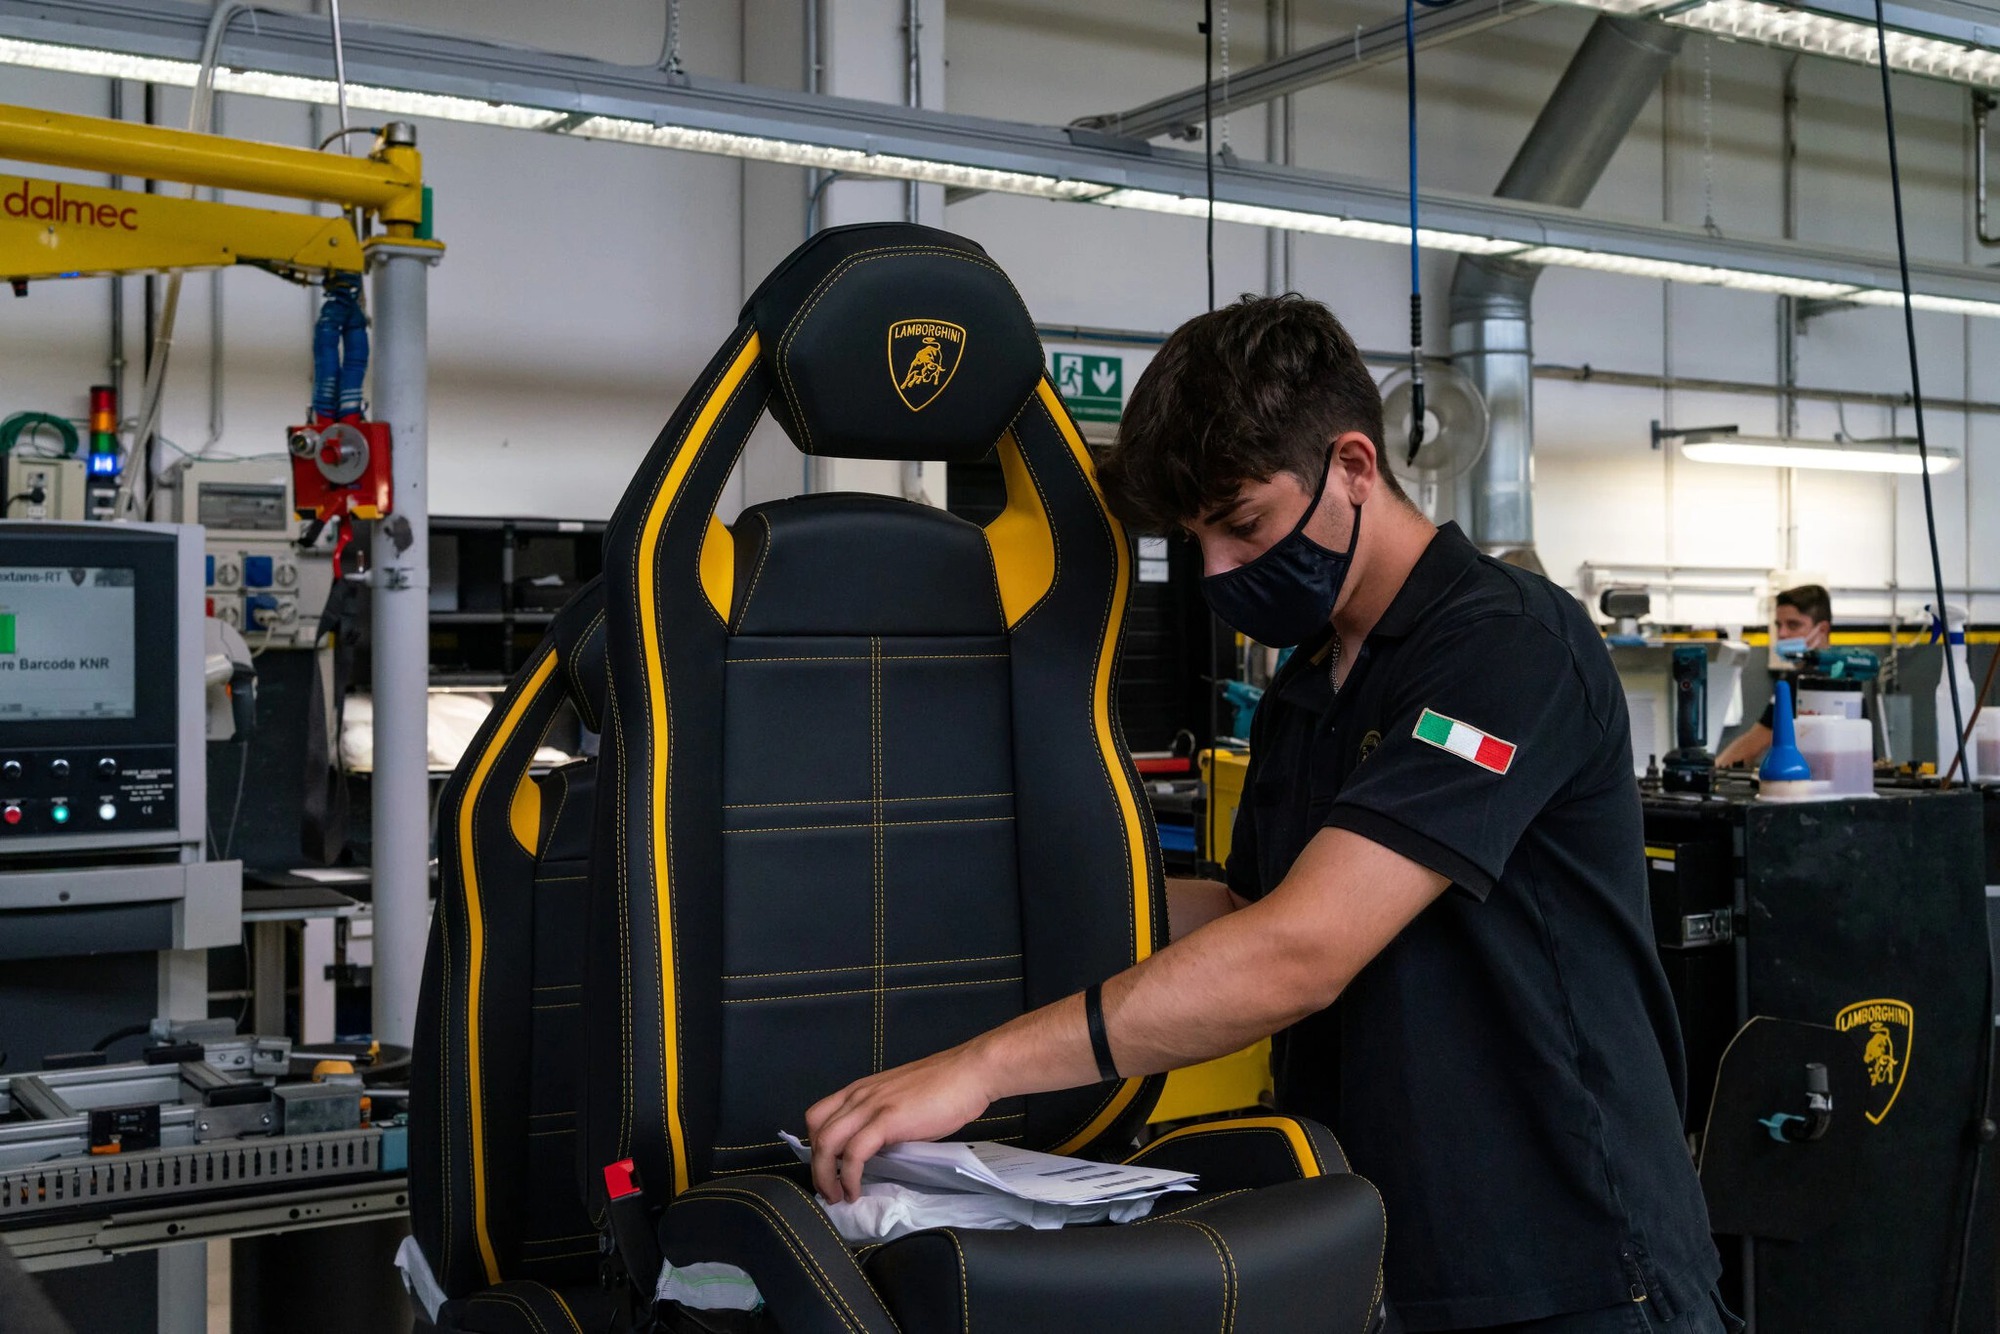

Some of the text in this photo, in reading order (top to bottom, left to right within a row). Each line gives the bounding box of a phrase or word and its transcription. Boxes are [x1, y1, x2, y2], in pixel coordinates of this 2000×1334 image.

[4, 180, 138, 230] dalmec
[894, 324, 961, 343] LAMBORGHINI
[0, 657, 109, 670] re Barcode KNR
[1841, 1005, 1908, 1032] LAMBORGHINI
